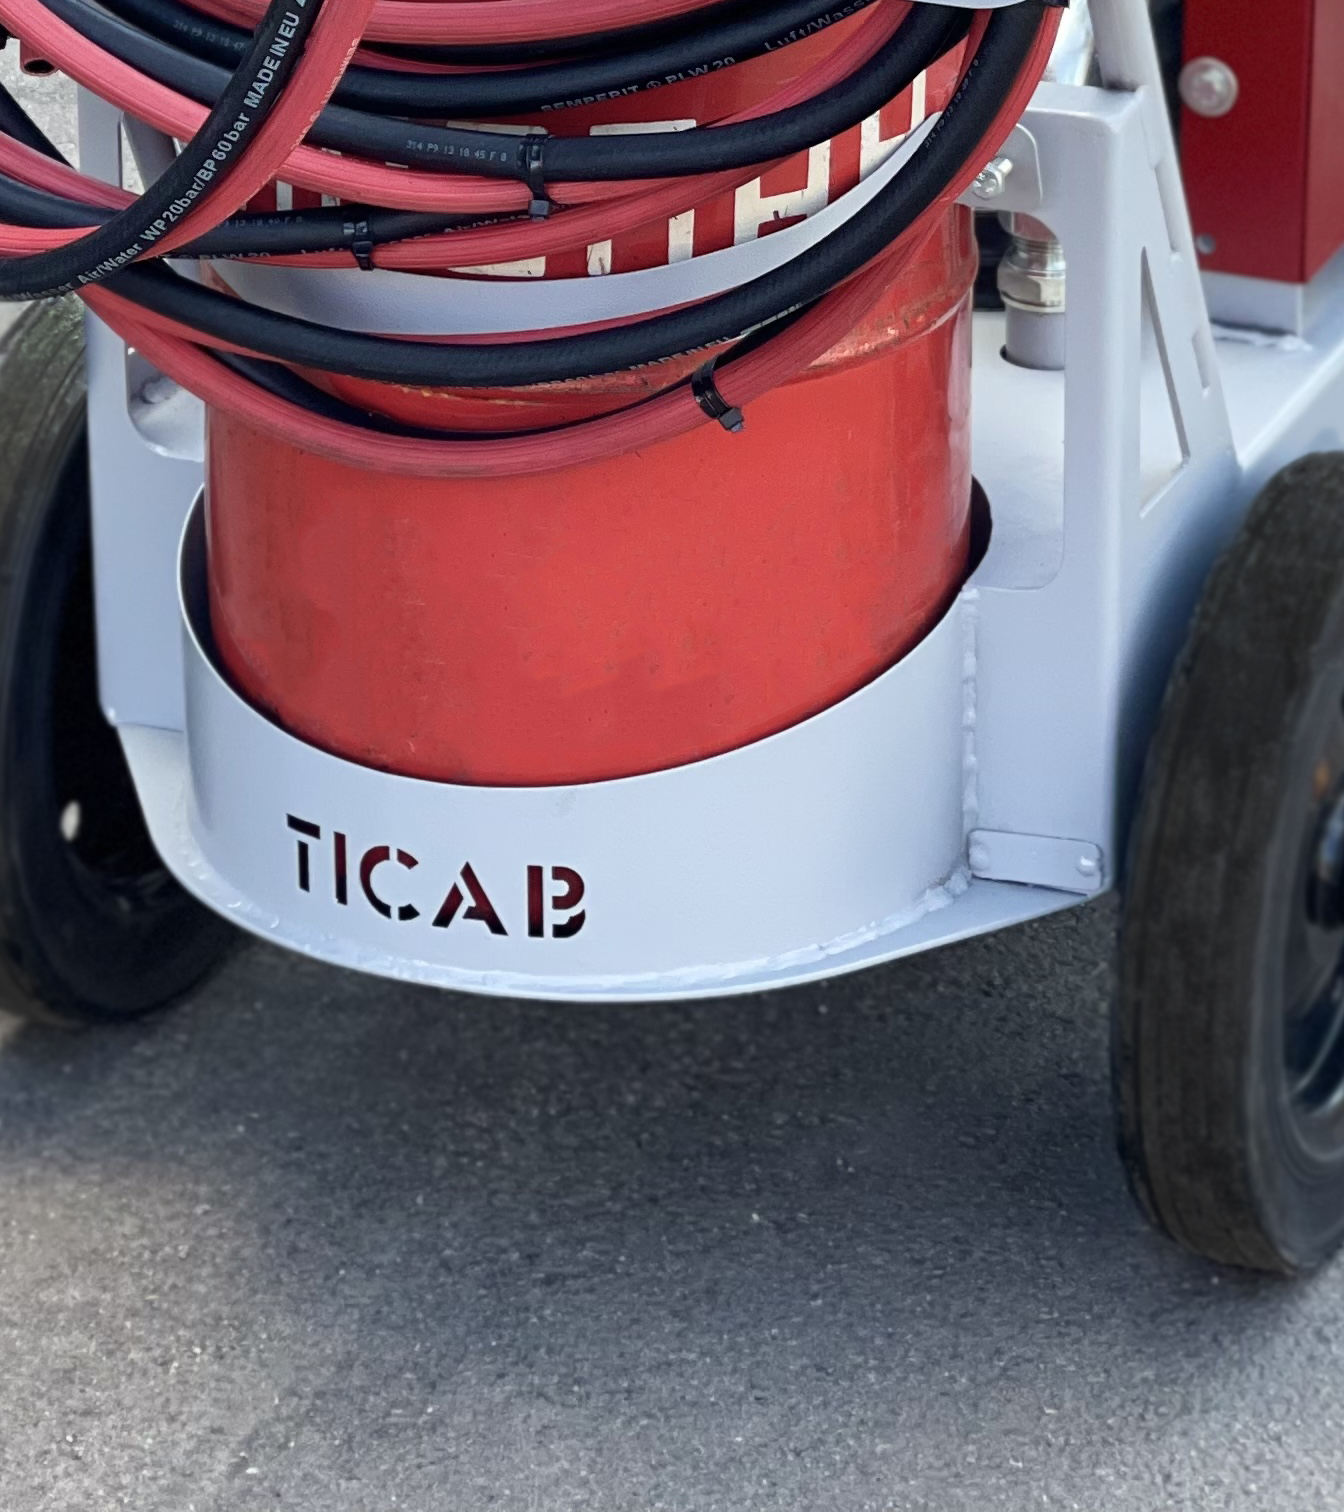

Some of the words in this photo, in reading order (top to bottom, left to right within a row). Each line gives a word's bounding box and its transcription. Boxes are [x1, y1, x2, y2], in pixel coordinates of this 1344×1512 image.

[76, 242, 143, 286] Air/Water
[242, 55, 282, 108] MADE
[278, 11, 300, 40] EU
[489, 151, 497, 161] F
[286, 813, 586, 939] TICAB
